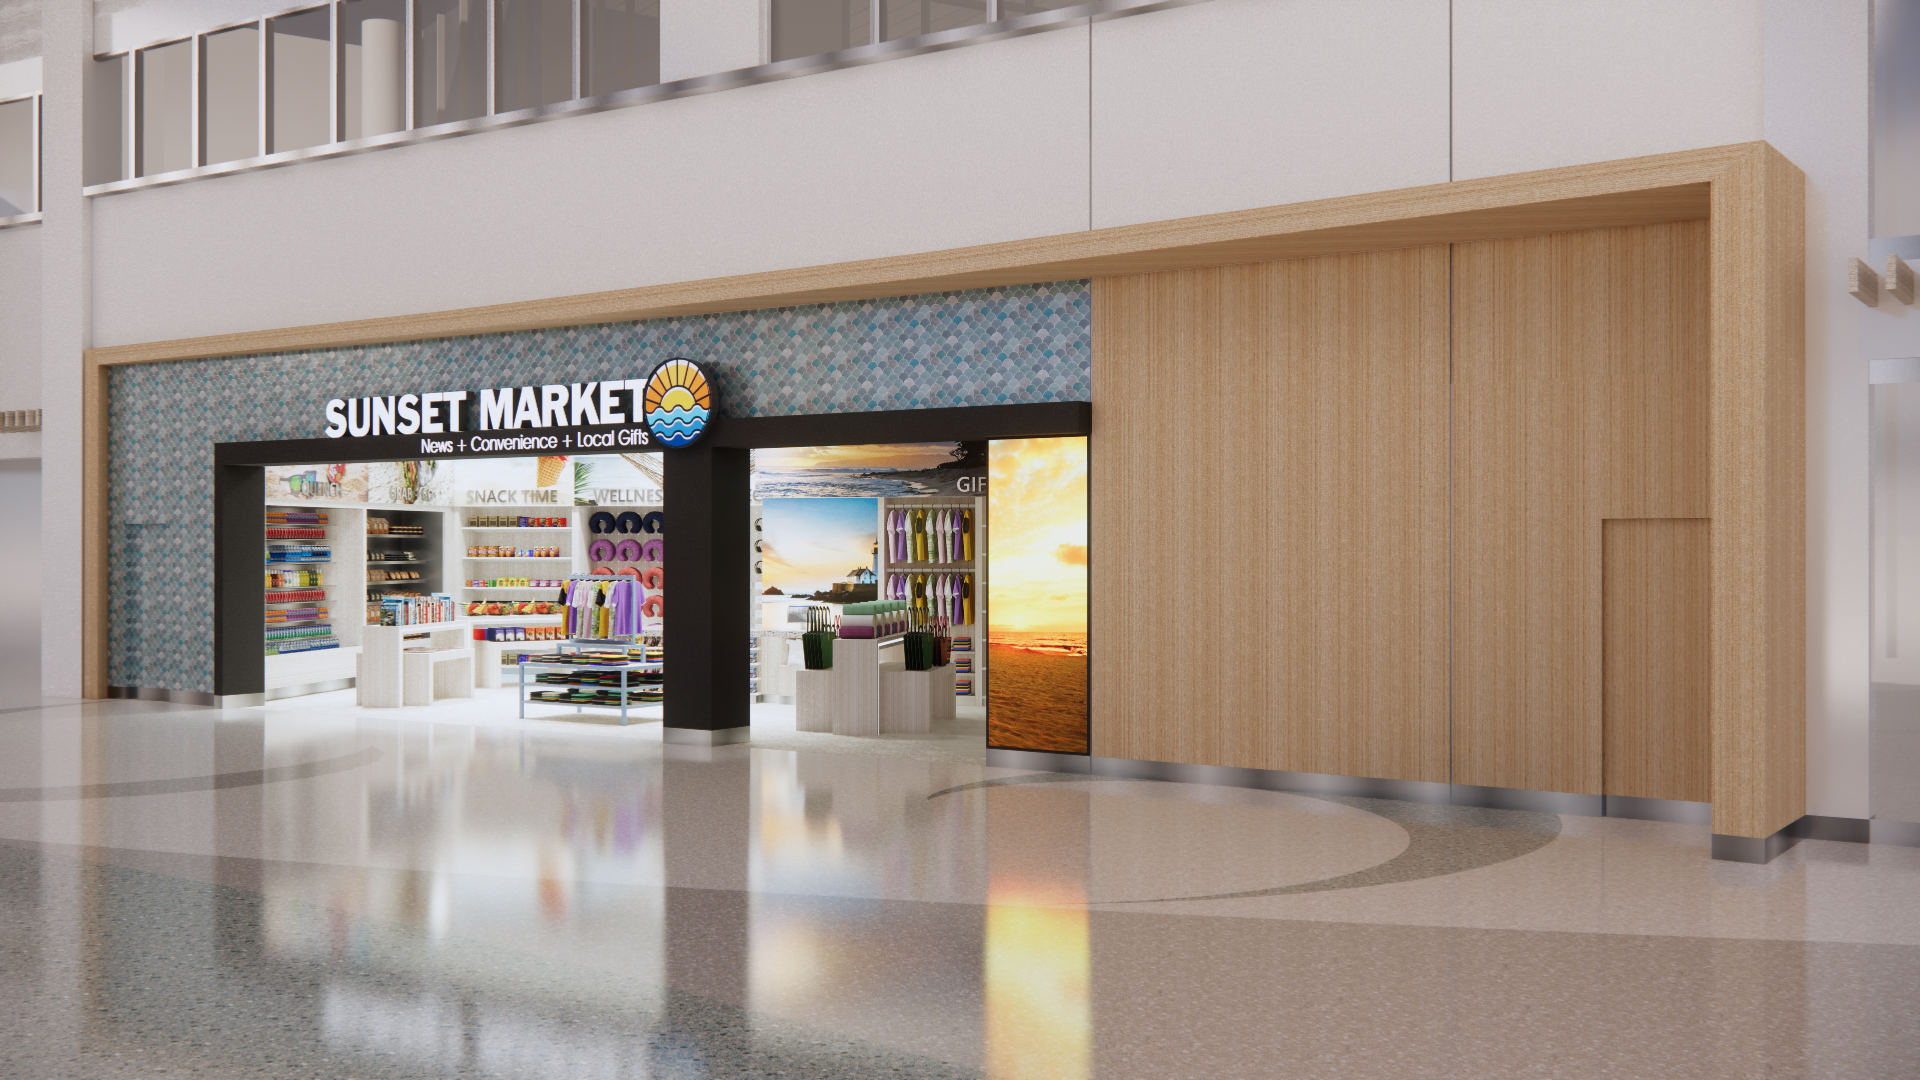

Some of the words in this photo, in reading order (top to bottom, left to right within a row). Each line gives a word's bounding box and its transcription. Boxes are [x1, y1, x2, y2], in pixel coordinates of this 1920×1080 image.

[324, 390, 467, 439] SUNSET
[479, 378, 649, 431] MARKET
[420, 438, 454, 454] News
[456, 438, 468, 452] +
[470, 434, 559, 452] Convenience
[562, 434, 573, 448] +
[577, 429, 615, 448] Local
[618, 428, 649, 446] Gifts
[301, 480, 343, 498] QUENCH
[389, 486, 414, 501] GRAB
[465, 489, 518, 503] SNACK
[520, 489, 558, 503] TIME
